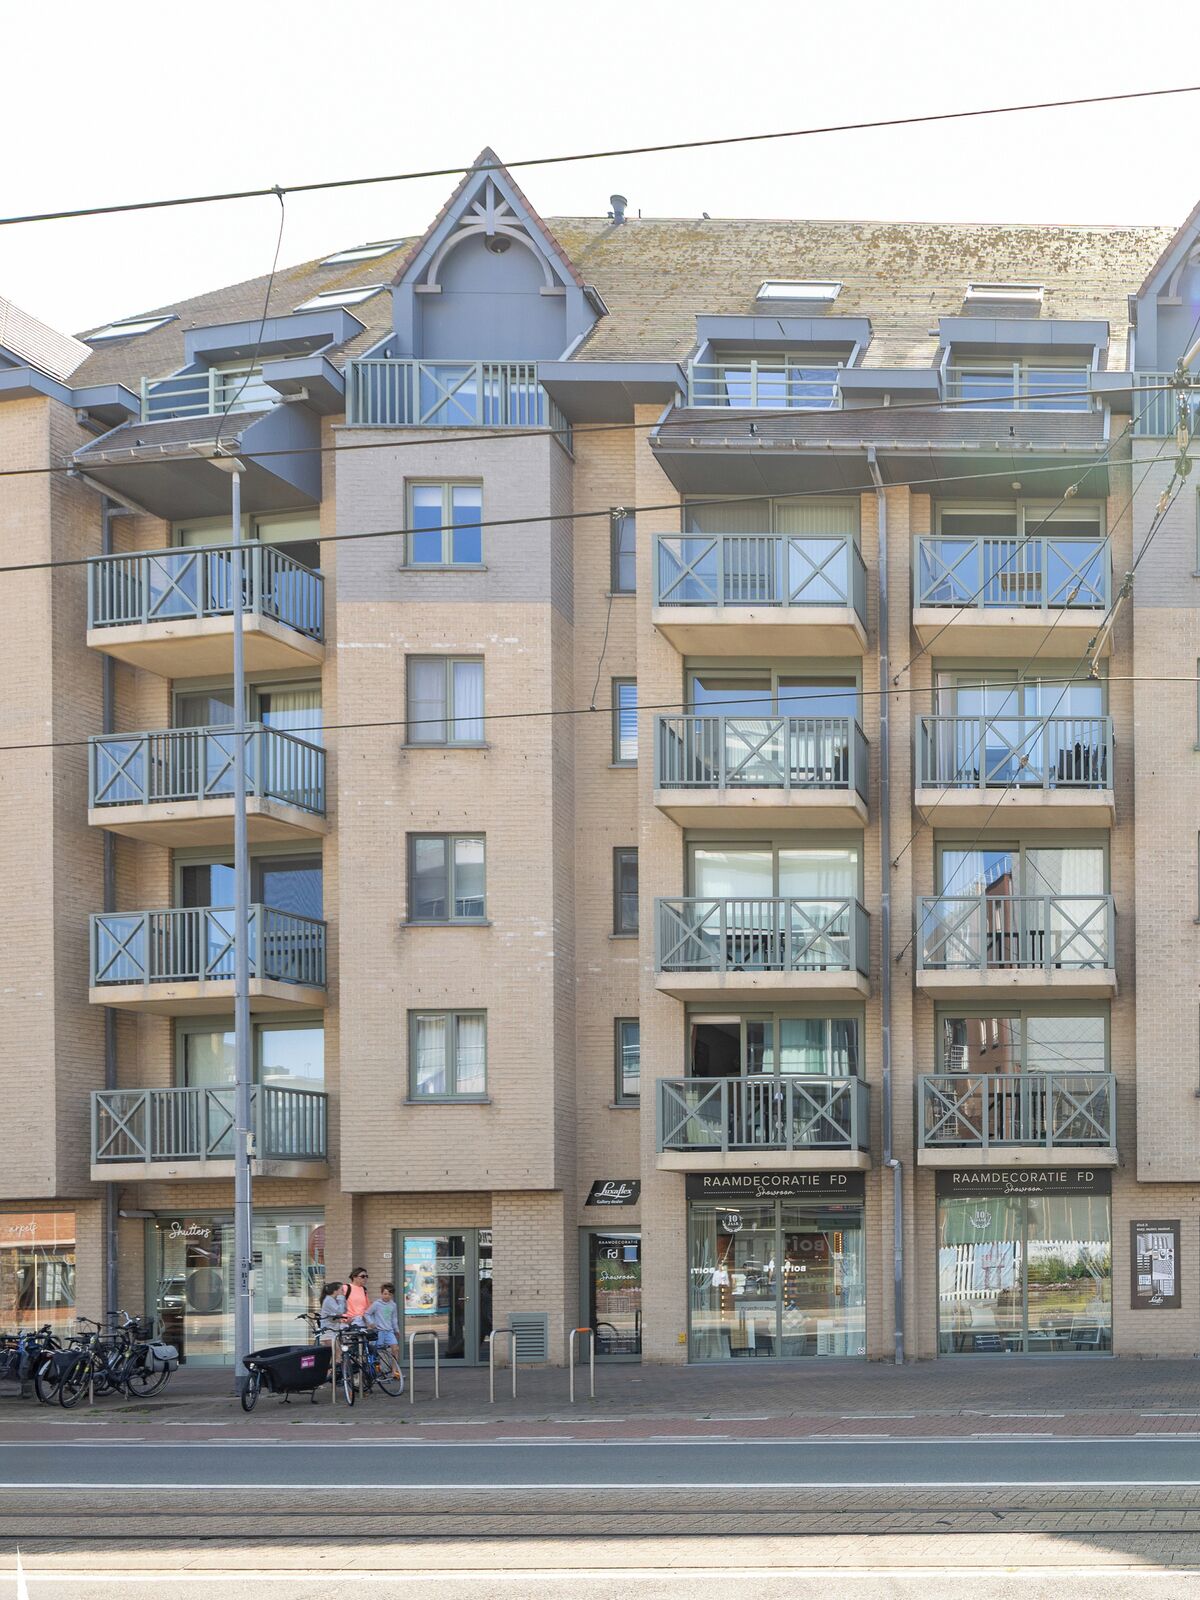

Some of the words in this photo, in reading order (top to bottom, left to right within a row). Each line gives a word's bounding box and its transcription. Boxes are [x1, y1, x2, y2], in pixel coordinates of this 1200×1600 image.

[703, 1175, 820, 1187] RAAMDECORATIE
[830, 1174, 848, 1185] FD
[953, 1172, 1068, 1183] RAAMDECORATIE
[1077, 1171, 1095, 1182] FD
[594, 1181, 633, 1199] Luxaflex
[755, 1185, 796, 1198] Showroom
[1004, 1182, 1044, 1194] Showroom
[728, 1214, 738, 1222] 10
[168, 1221, 211, 1239] Shutters
[440, 1262, 460, 1271] 305
[599, 1270, 637, 1281] Showroom
